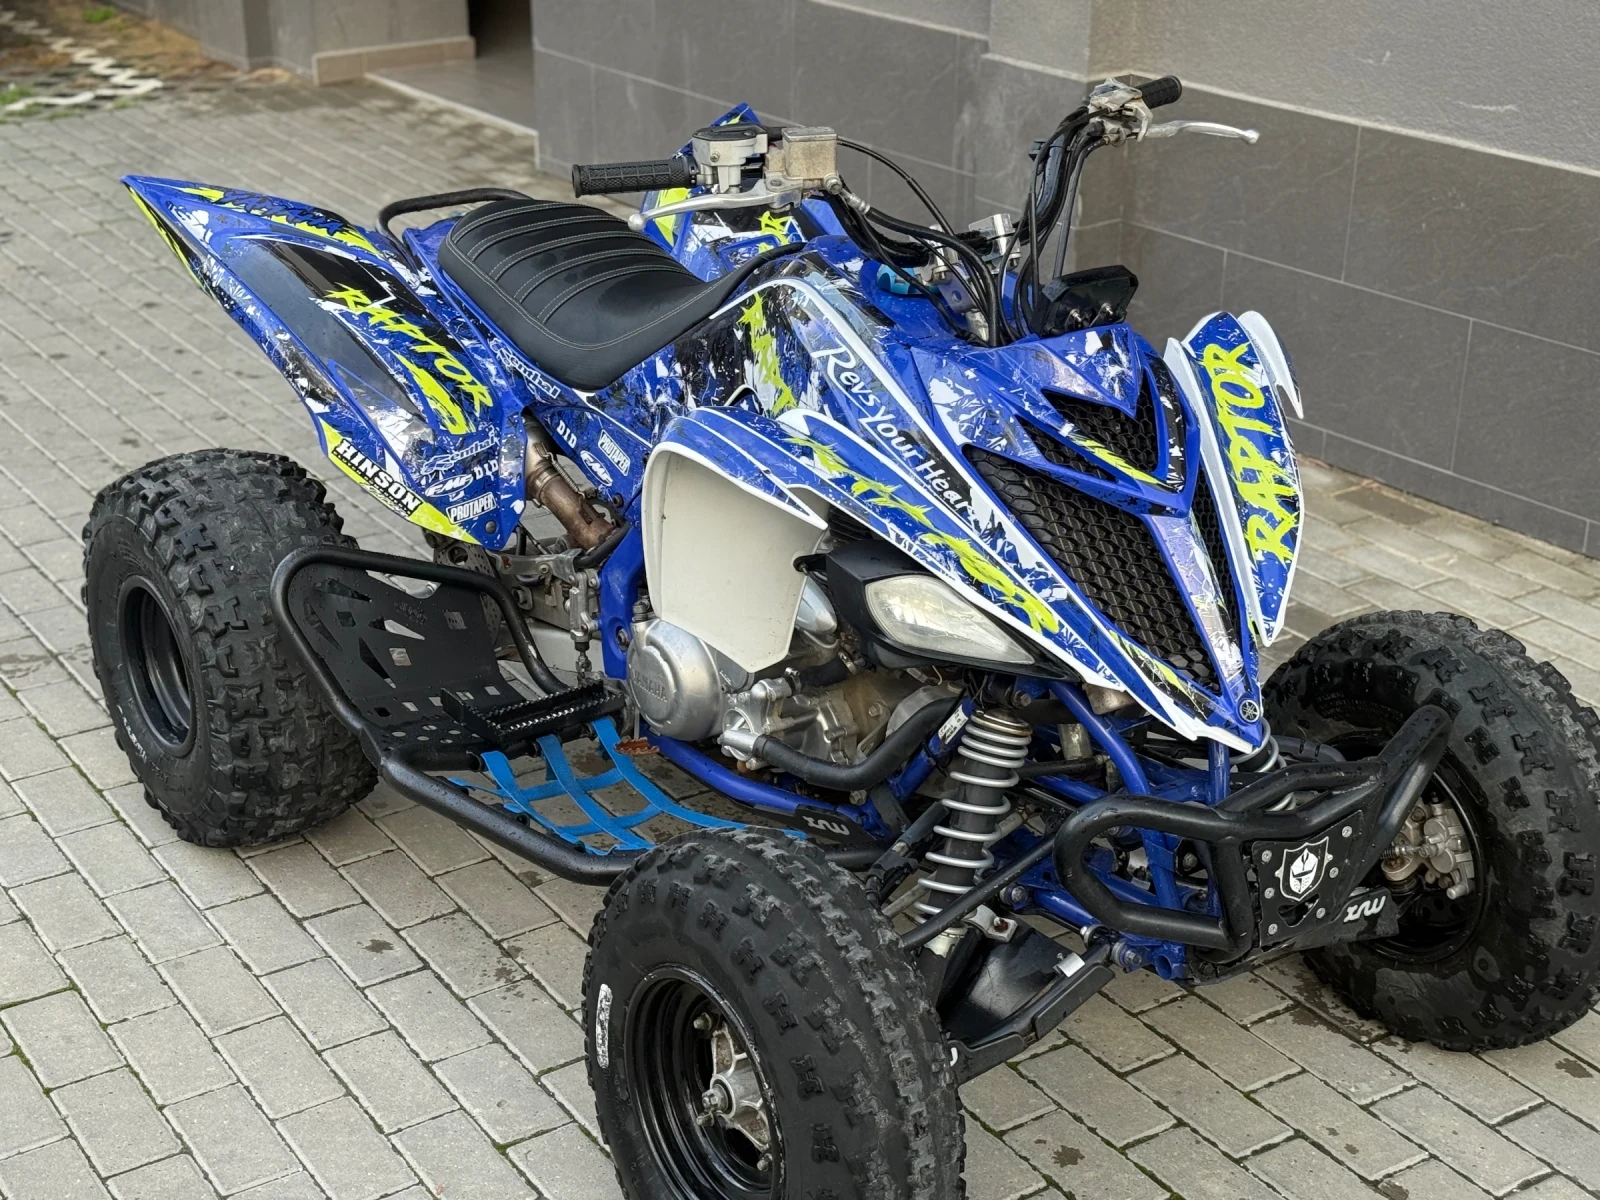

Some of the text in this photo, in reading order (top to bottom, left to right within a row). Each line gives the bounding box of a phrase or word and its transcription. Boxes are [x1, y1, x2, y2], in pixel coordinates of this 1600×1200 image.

[323, 282, 494, 418] RAPTOR
[810, 335, 882, 407] Revs
[858, 405, 926, 460] Your
[335, 440, 421, 511] HINSON
[600, 432, 629, 473] PROTAPER
[1199, 340, 1300, 572] RAPTOR
[450, 497, 495, 522] PROTAPER
